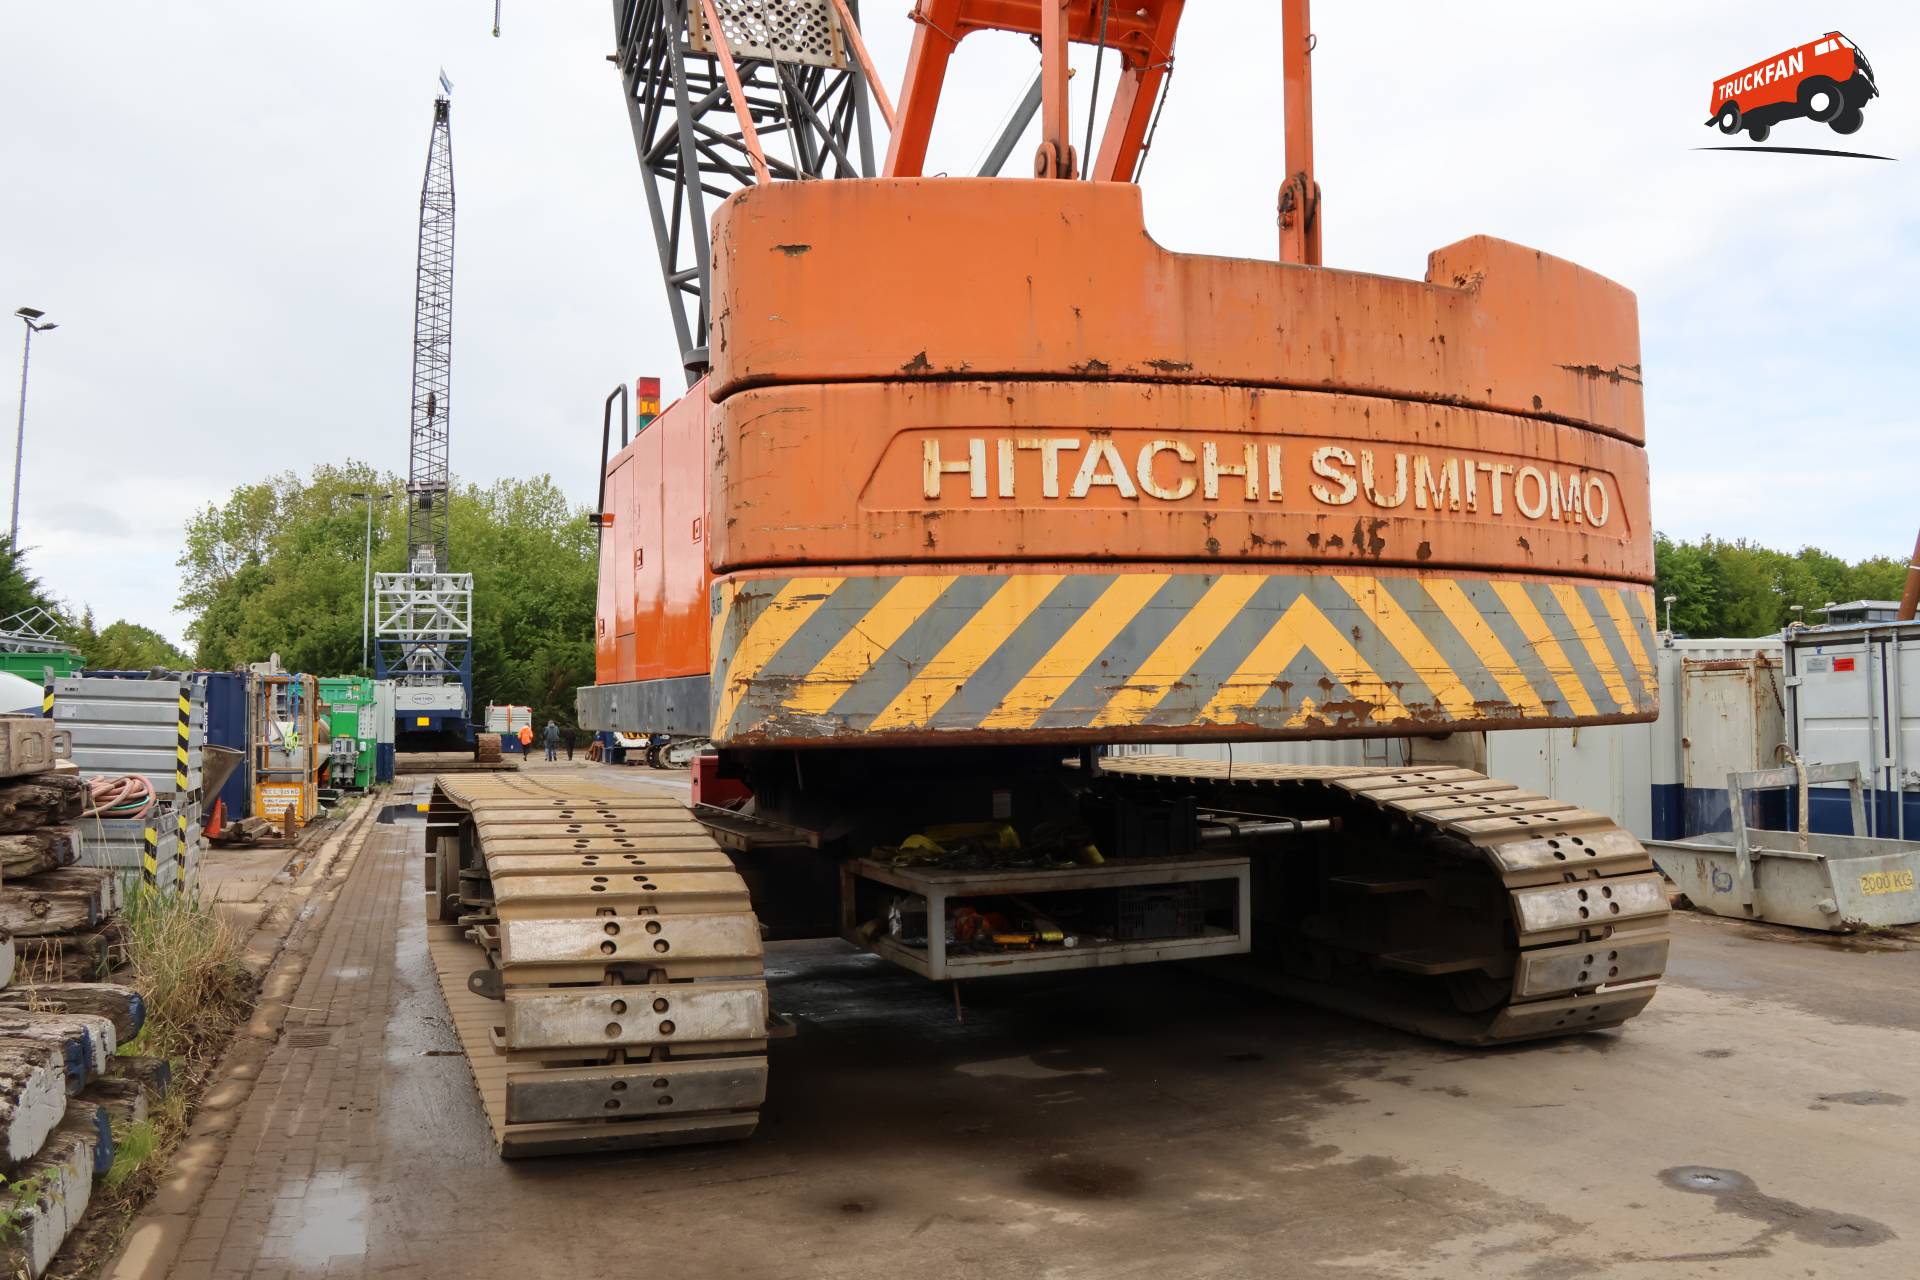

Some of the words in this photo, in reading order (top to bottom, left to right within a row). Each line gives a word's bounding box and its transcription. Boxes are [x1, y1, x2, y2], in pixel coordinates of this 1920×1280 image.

[922, 438, 1283, 501] HITACHI
[1310, 446, 1609, 528] SUMITOMO
[1861, 876, 1891, 891] 2000
[1893, 872, 1913, 887] KG
